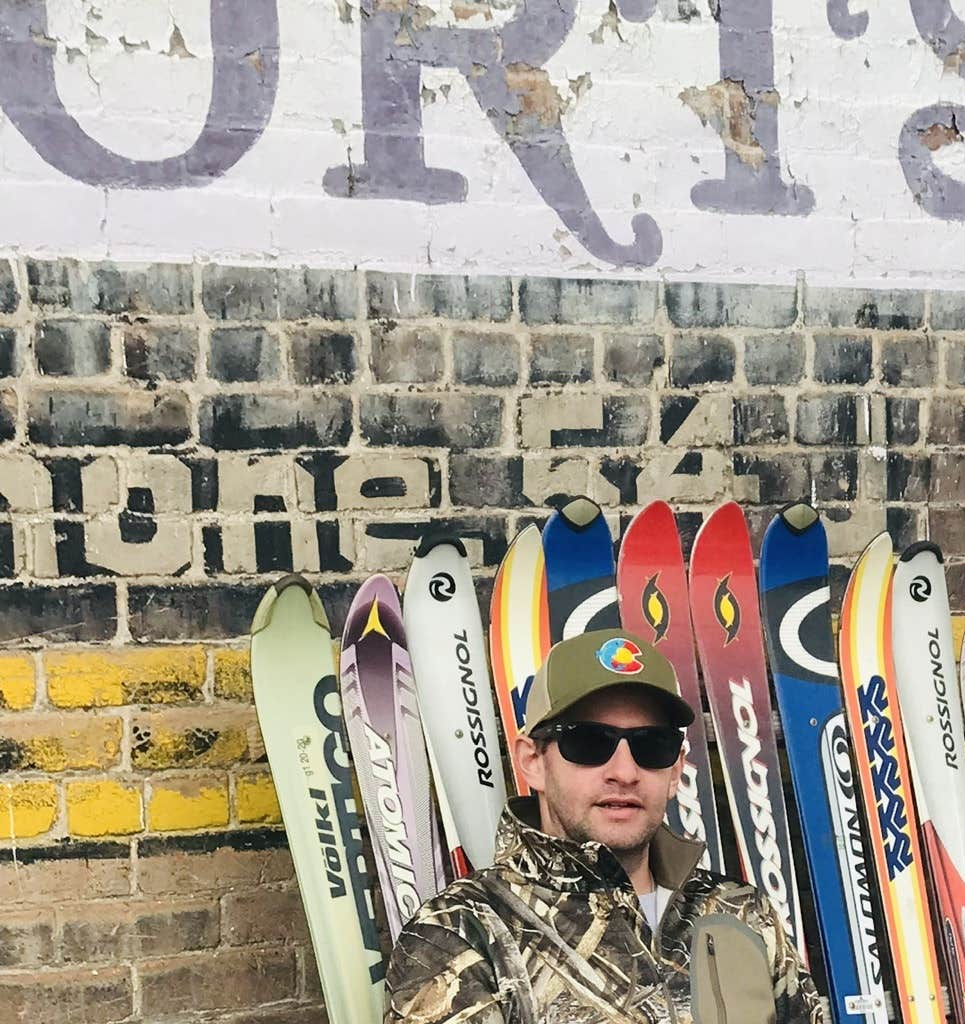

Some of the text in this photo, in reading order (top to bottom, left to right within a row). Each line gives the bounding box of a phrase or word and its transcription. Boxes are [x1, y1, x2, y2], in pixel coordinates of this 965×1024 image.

[454, 629, 494, 788] ROSSIGNOL
[928, 628, 959, 770] ROSSIGNOL
[364, 722, 422, 920] ATOMIC
[845, 806, 882, 985] SALOMON
